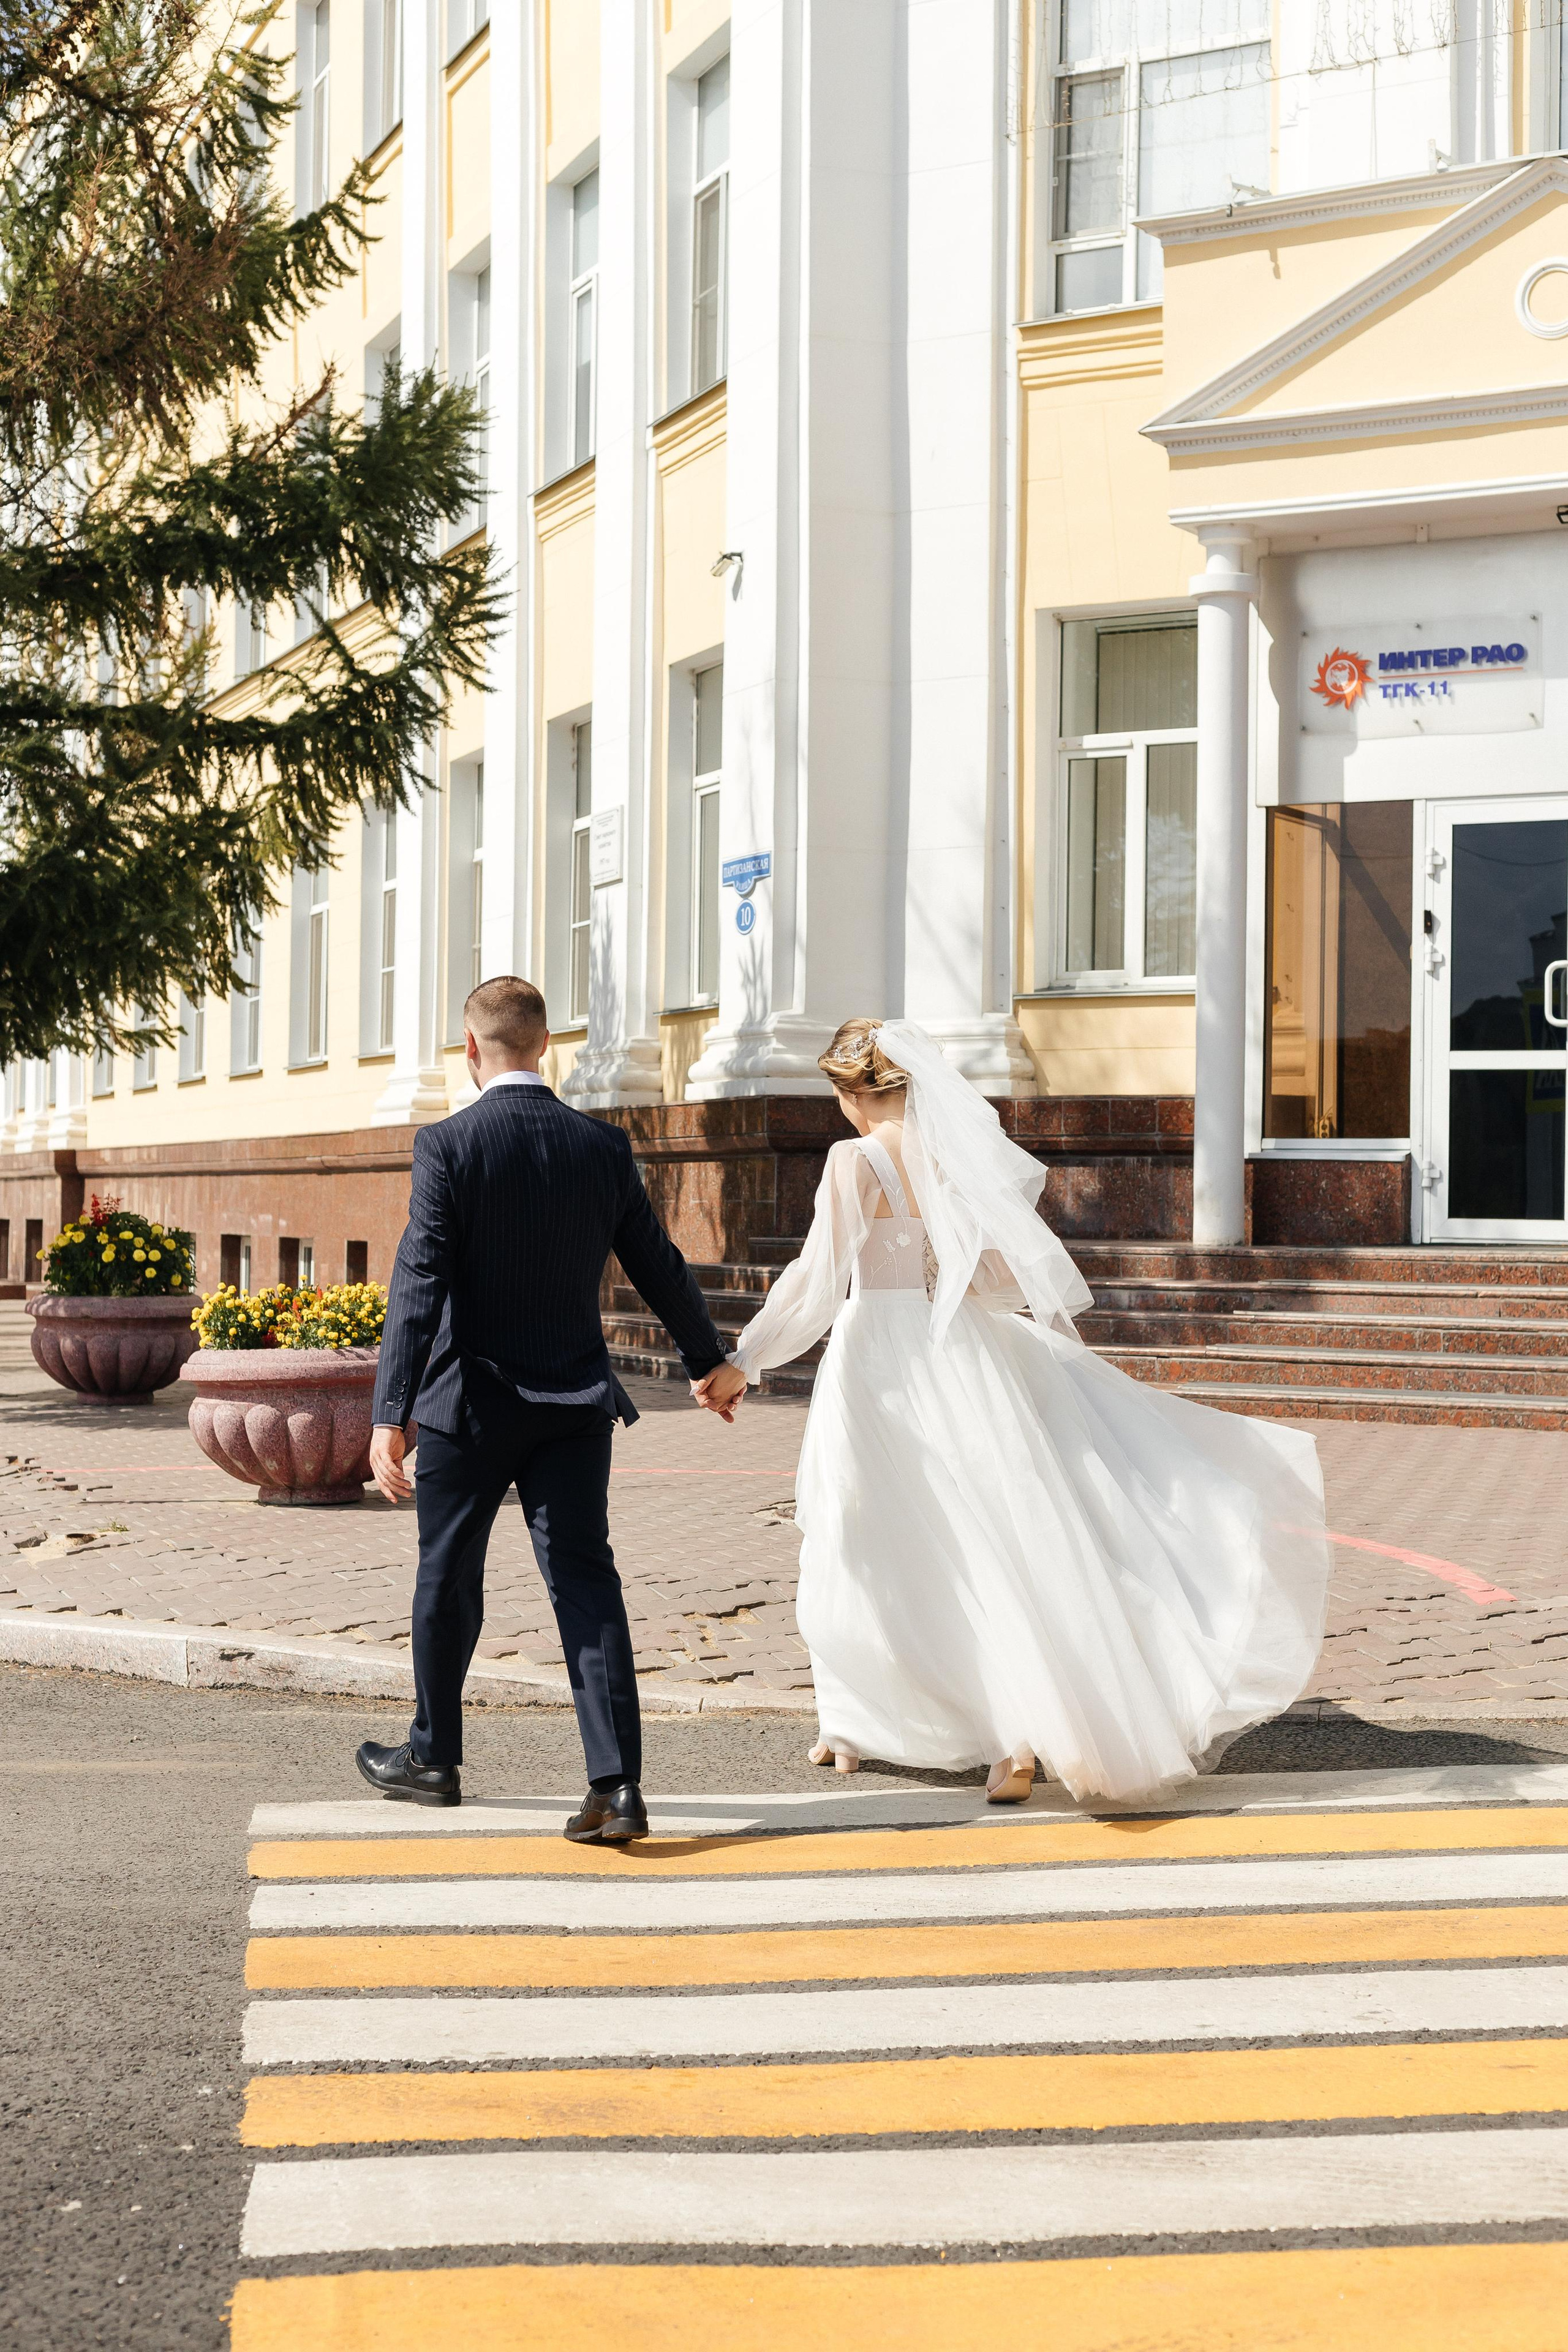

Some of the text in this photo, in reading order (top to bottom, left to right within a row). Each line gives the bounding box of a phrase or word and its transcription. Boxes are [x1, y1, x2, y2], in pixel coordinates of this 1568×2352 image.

[1379, 643, 1525, 670] ИНТЕР РАО
[1379, 680, 1448, 698] ТГК-11
[723, 858, 769, 878] ПАРТИЗАНСКАЯ
[741, 906, 751, 926] 10
